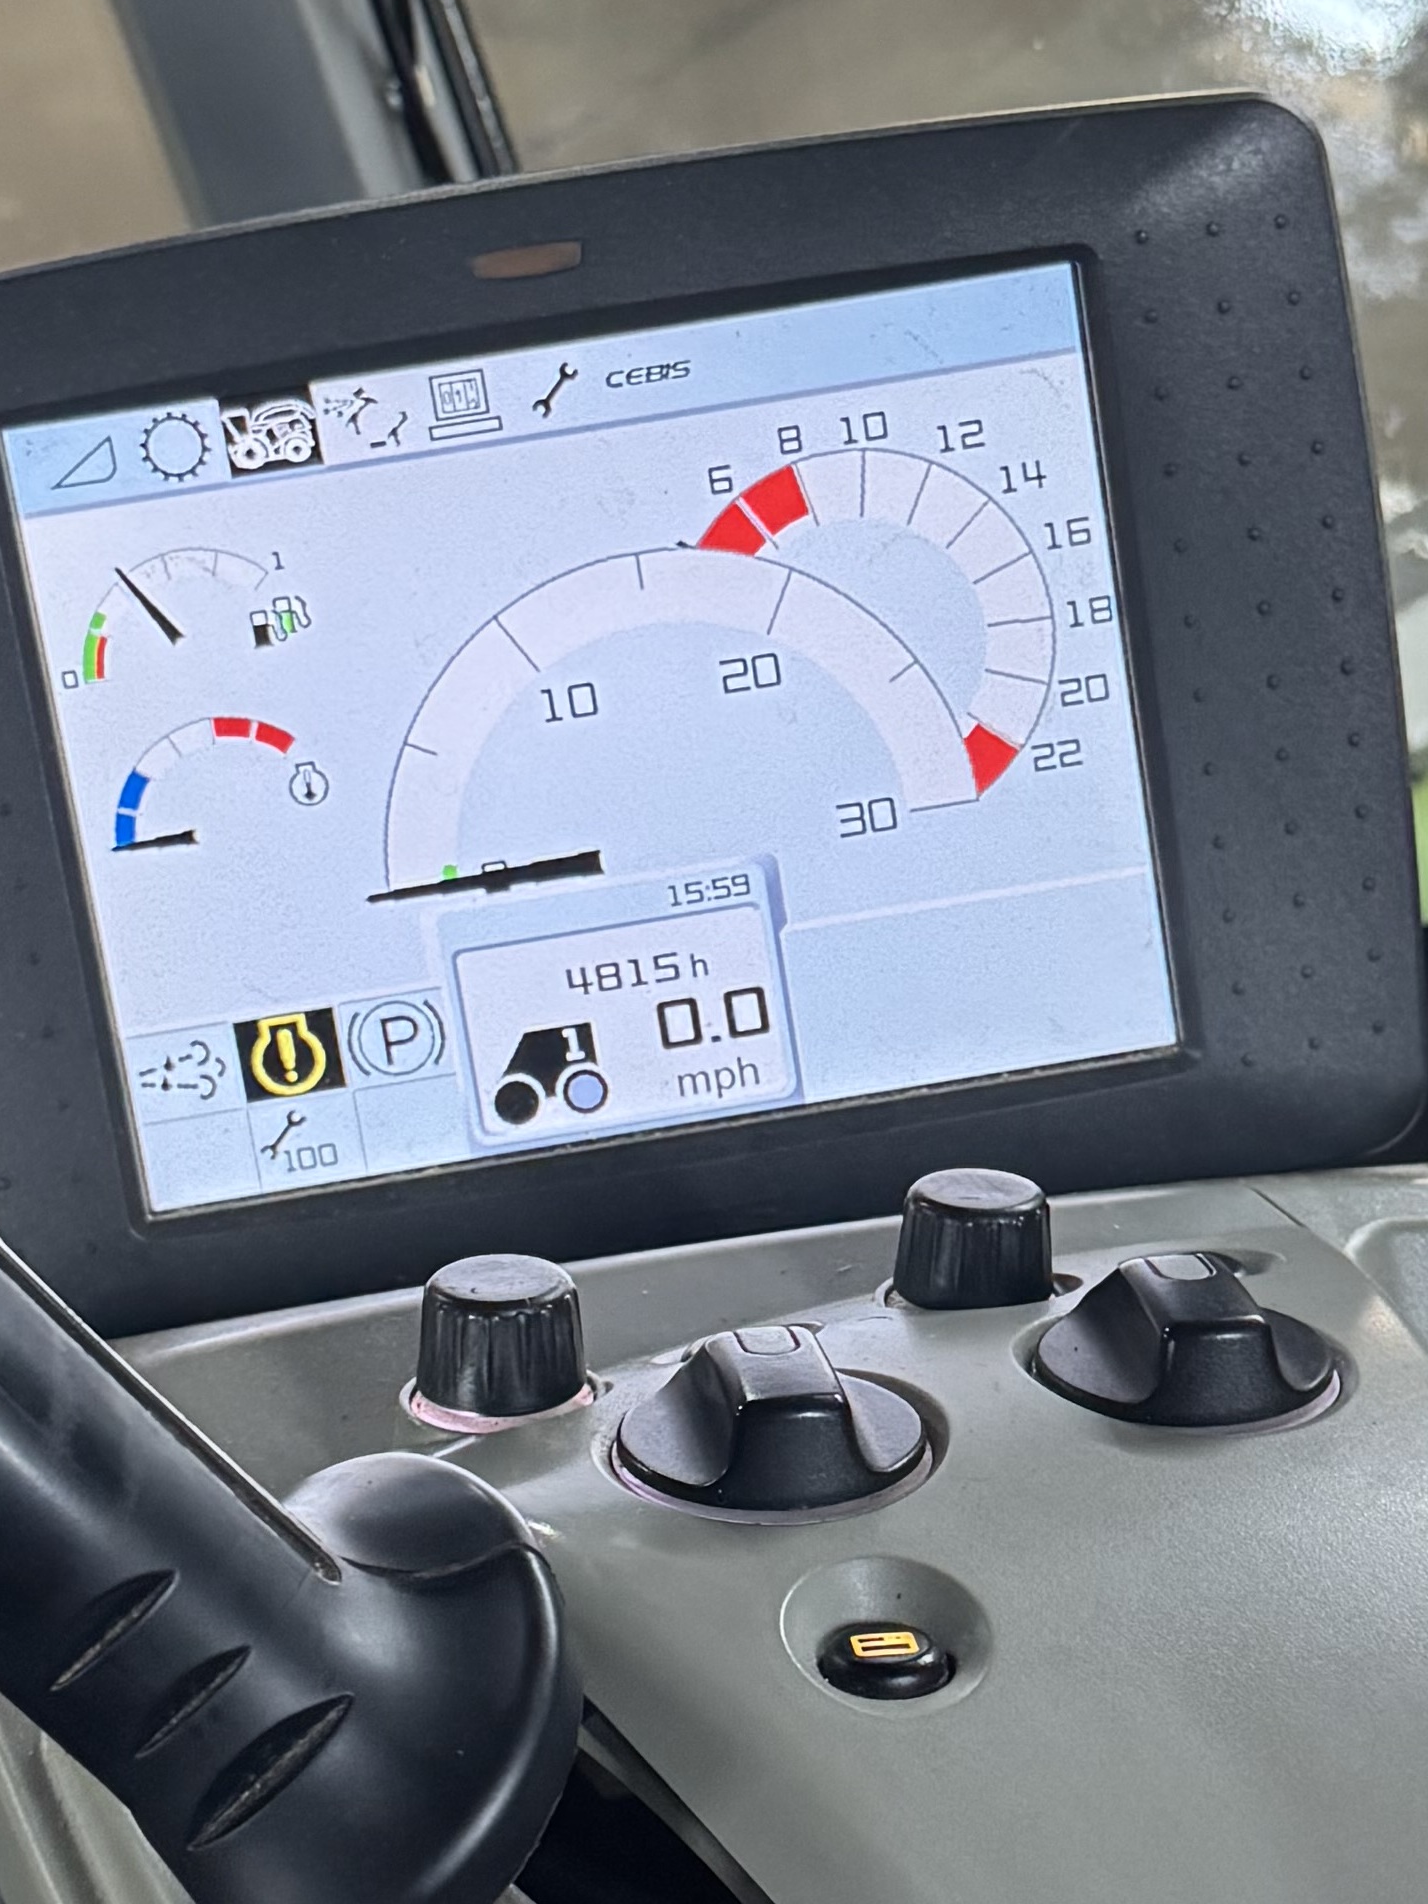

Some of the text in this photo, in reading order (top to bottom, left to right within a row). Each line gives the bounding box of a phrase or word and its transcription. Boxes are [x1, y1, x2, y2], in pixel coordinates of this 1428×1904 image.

[605, 359, 692, 389] CEBIS
[777, 424, 803, 455] 8
[840, 411, 889, 445] 10
[936, 419, 986, 454] 12
[707, 465, 734, 495] 6
[999, 459, 1047, 495] 14
[1043, 516, 1092, 550] 16
[1065, 595, 1113, 628] 18
[719, 652, 782, 694] 20
[1058, 673, 1110, 707] 20
[540, 682, 599, 723] 10
[1031, 738, 1084, 772] 22
[835, 797, 898, 838] 30
[667, 873, 751, 907] 15:59
[656, 986, 770, 1050] 0.0
[677, 1056, 761, 1099] mph
[283, 1142, 339, 1173] 100
